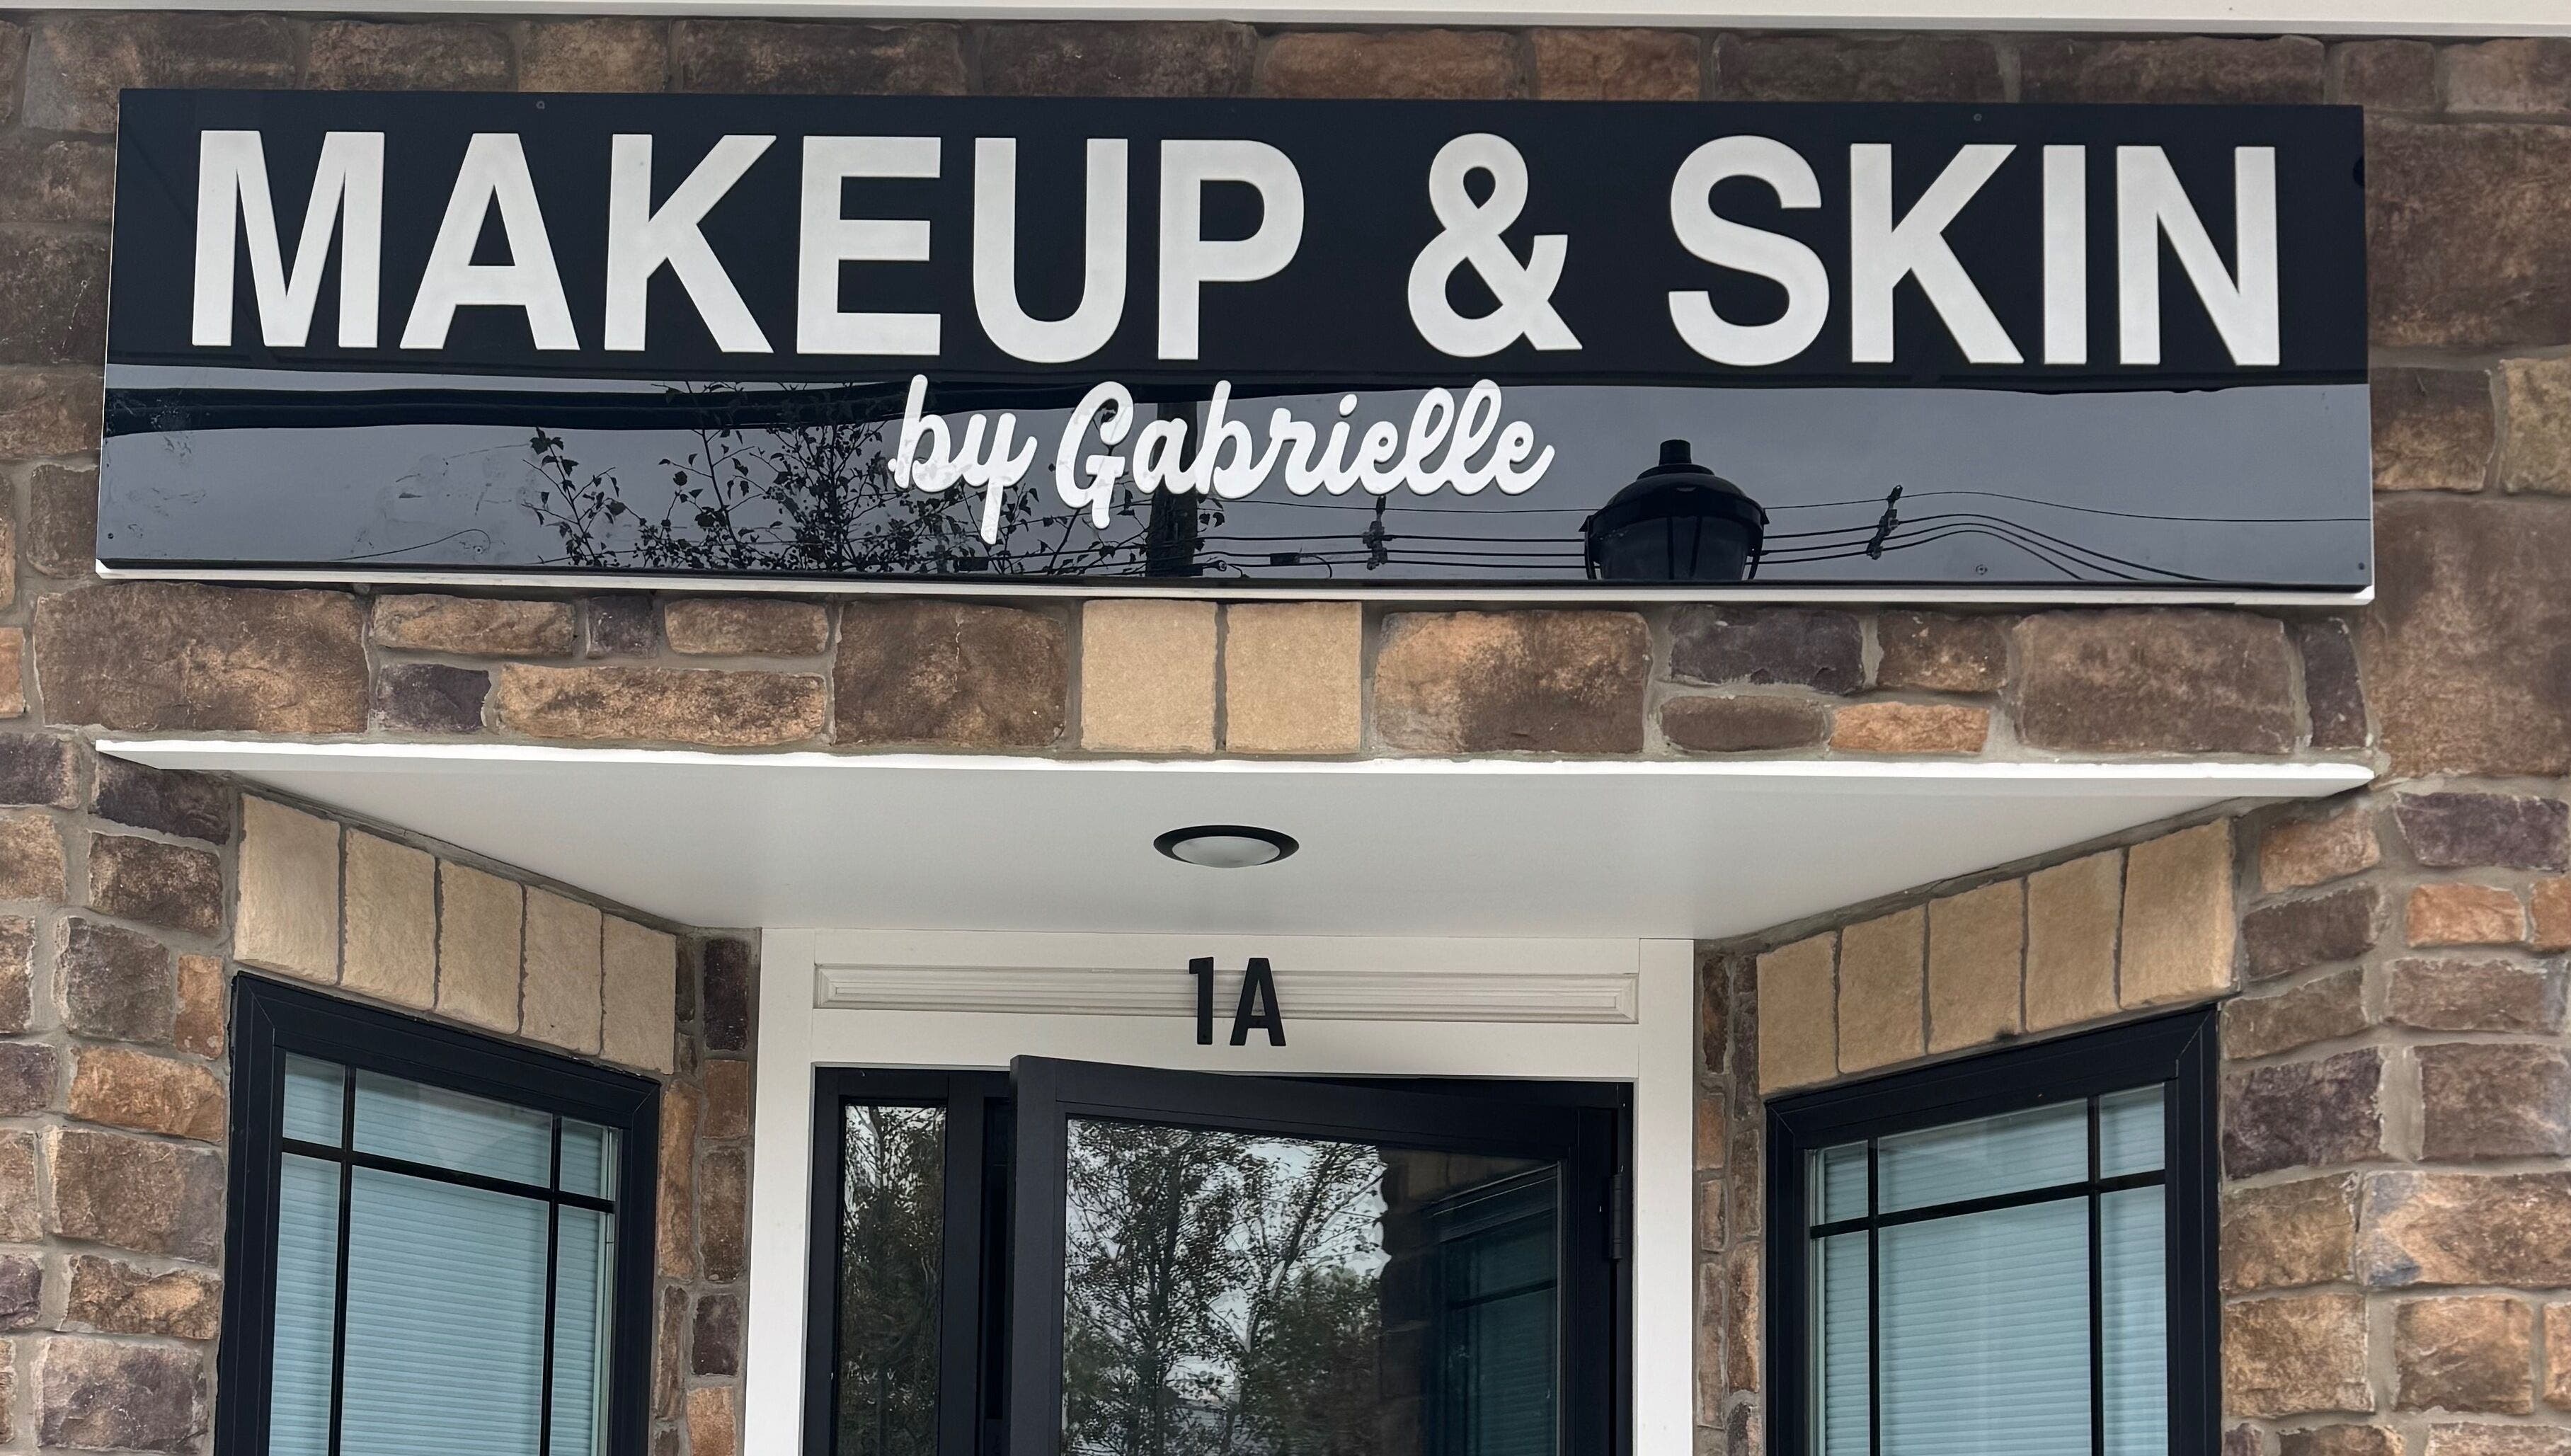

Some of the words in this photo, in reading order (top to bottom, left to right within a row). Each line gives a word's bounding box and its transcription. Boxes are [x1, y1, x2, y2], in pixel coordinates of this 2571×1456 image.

[192, 130, 1305, 363] MAKEUP
[1407, 133, 1583, 357] &
[1668, 135, 2280, 366] SKIN
[887, 374, 1038, 545] by
[1055, 379, 1555, 530] Gabrielle
[1189, 956, 1287, 1048] 1A
